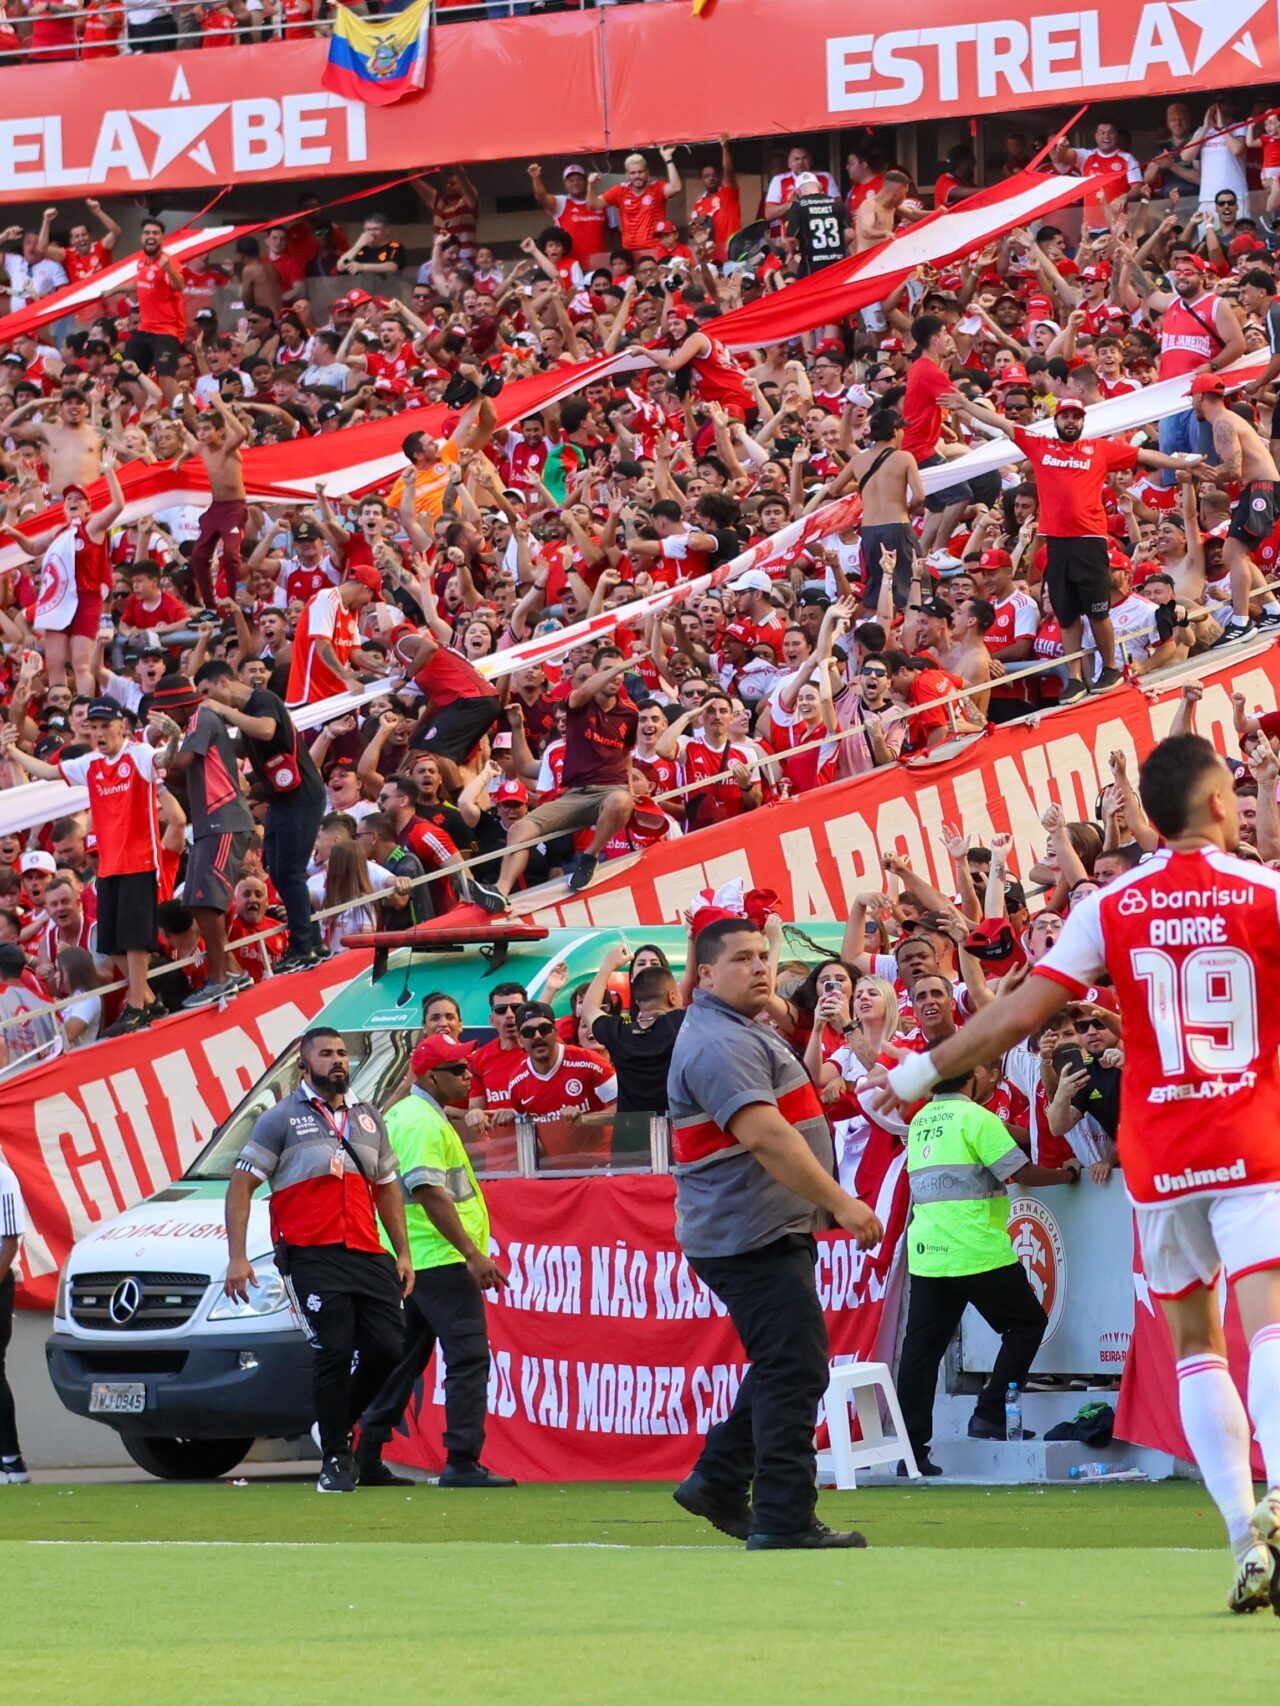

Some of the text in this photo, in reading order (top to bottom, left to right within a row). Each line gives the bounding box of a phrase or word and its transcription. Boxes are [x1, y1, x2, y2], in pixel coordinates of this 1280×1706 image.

[809, 217, 841, 250] 33
[1042, 454, 1091, 471] Banrisul
[1151, 886, 1254, 911] banrisul
[1150, 913, 1228, 947] BORRÉ
[1130, 945, 1260, 1077] 19
[1153, 1158, 1247, 1194] Unimed
[505, 1242, 582, 1315] AMOR
[591, 1240, 648, 1319] NÃO
[521, 1354, 569, 1430] VAI
[576, 1361, 690, 1436] MORRER
